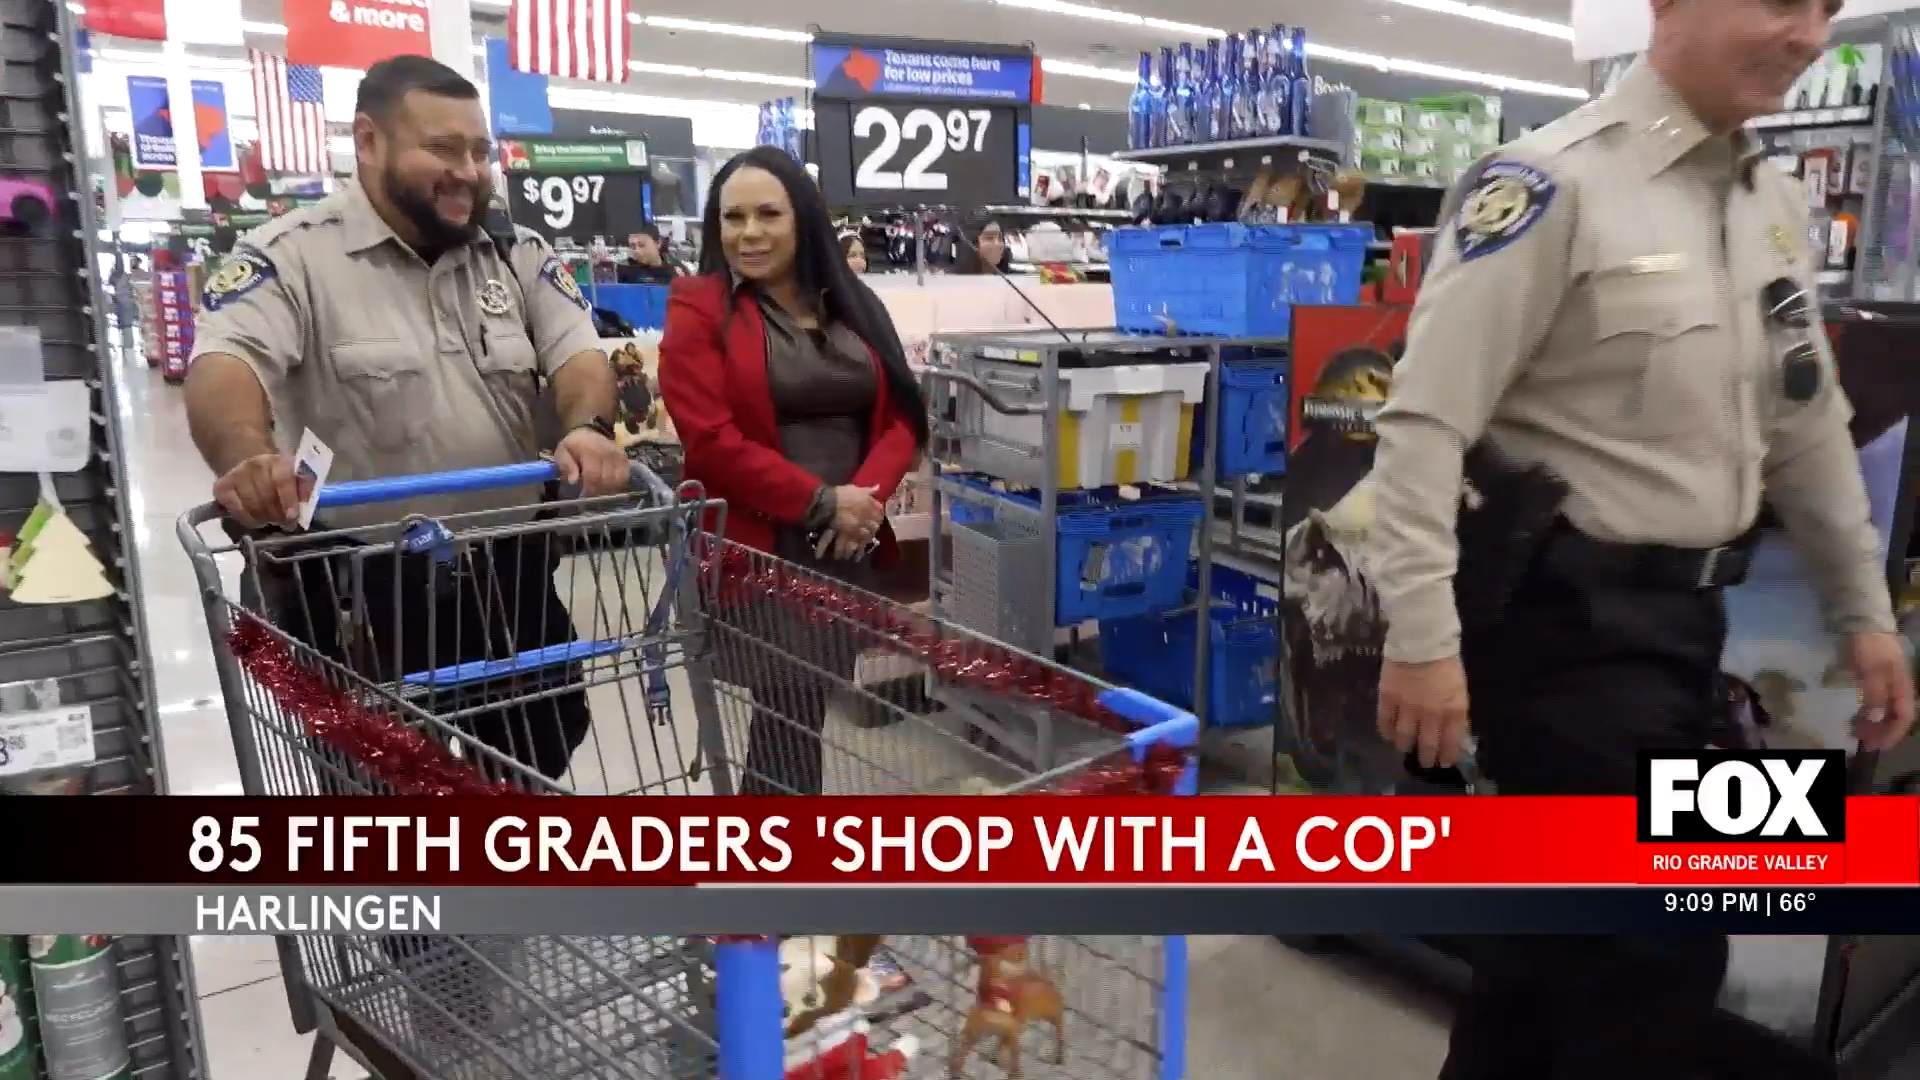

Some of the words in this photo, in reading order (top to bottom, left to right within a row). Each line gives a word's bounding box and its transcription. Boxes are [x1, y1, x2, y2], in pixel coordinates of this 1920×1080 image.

[329, 0, 351, 24] &
[354, 6, 425, 32] more
[884, 64, 903, 81] for
[906, 66, 931, 83] low
[932, 70, 973, 87] prices
